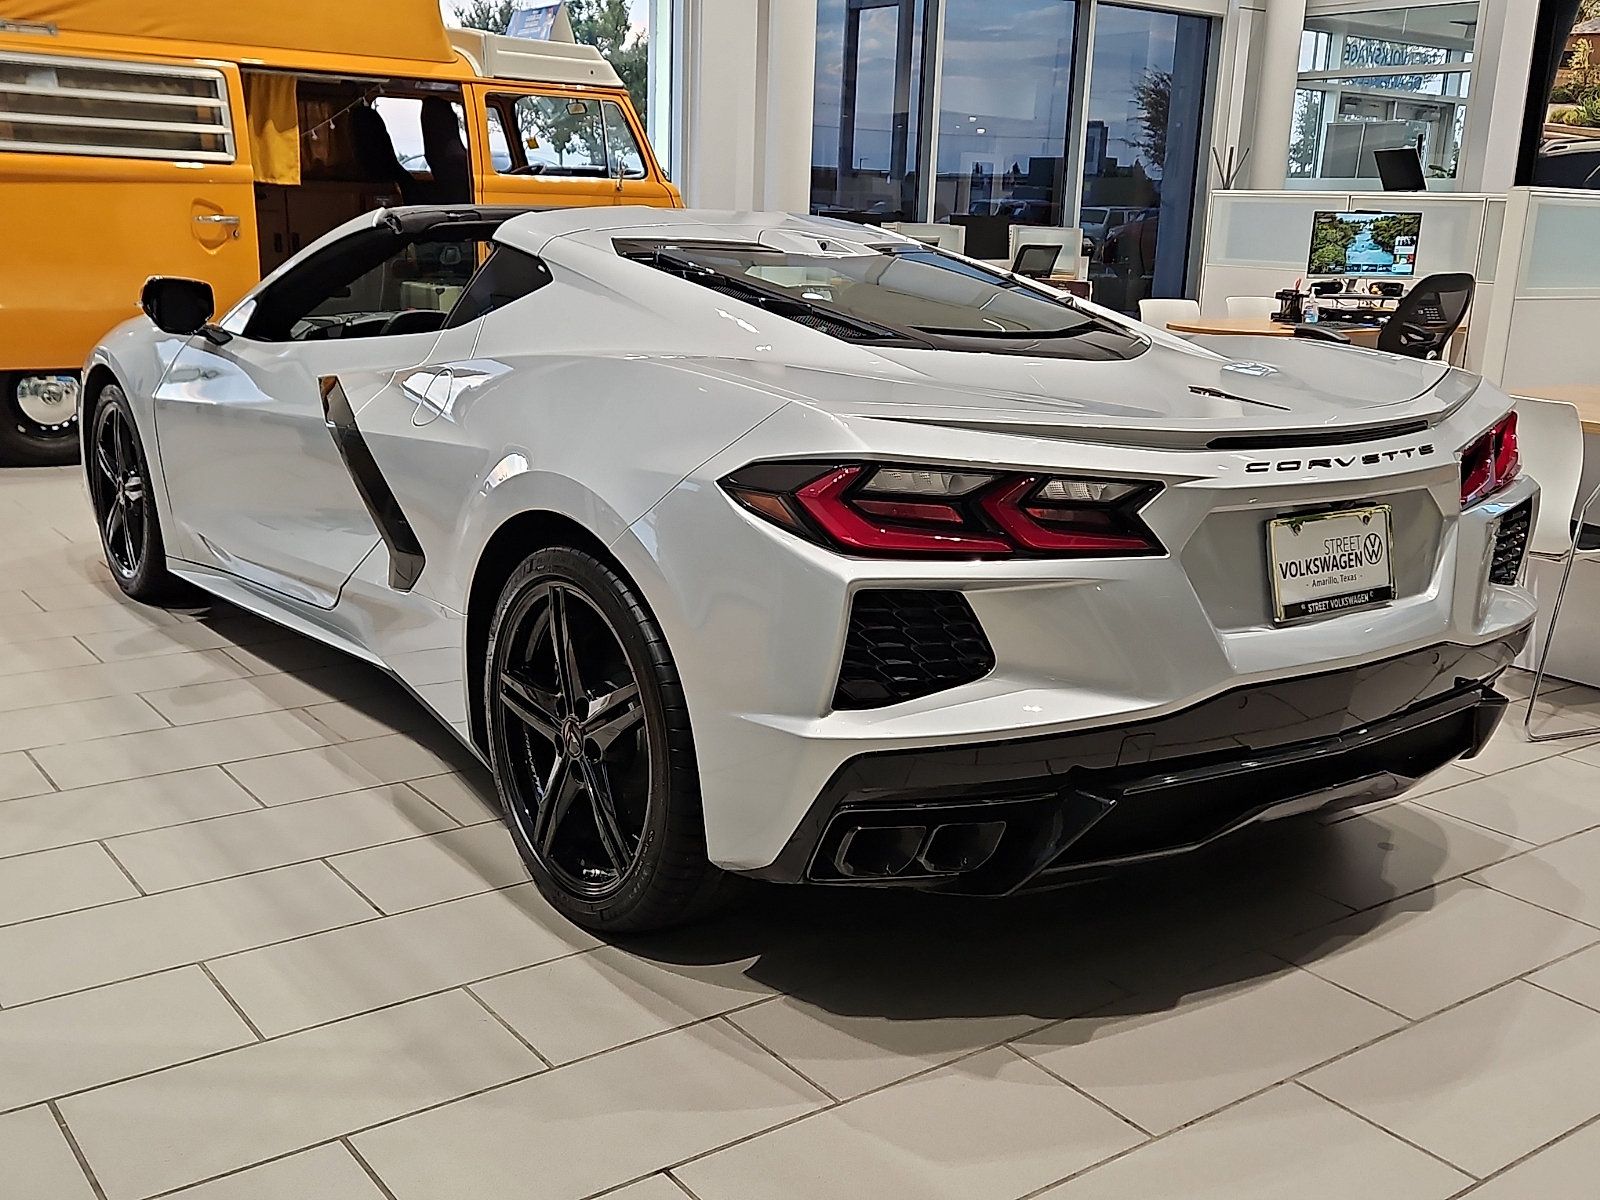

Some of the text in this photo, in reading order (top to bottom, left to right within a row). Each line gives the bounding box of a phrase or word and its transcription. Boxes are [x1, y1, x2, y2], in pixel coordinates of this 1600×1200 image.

[1245, 444, 1435, 473] CORVETTE
[1323, 534, 1362, 556] STREET
[1279, 551, 1363, 579] VOLKSWAGEN
[1311, 573, 1357, 588] Amarillo, Texas
[1307, 593, 1370, 613] STREET VOLKSWAGEN
